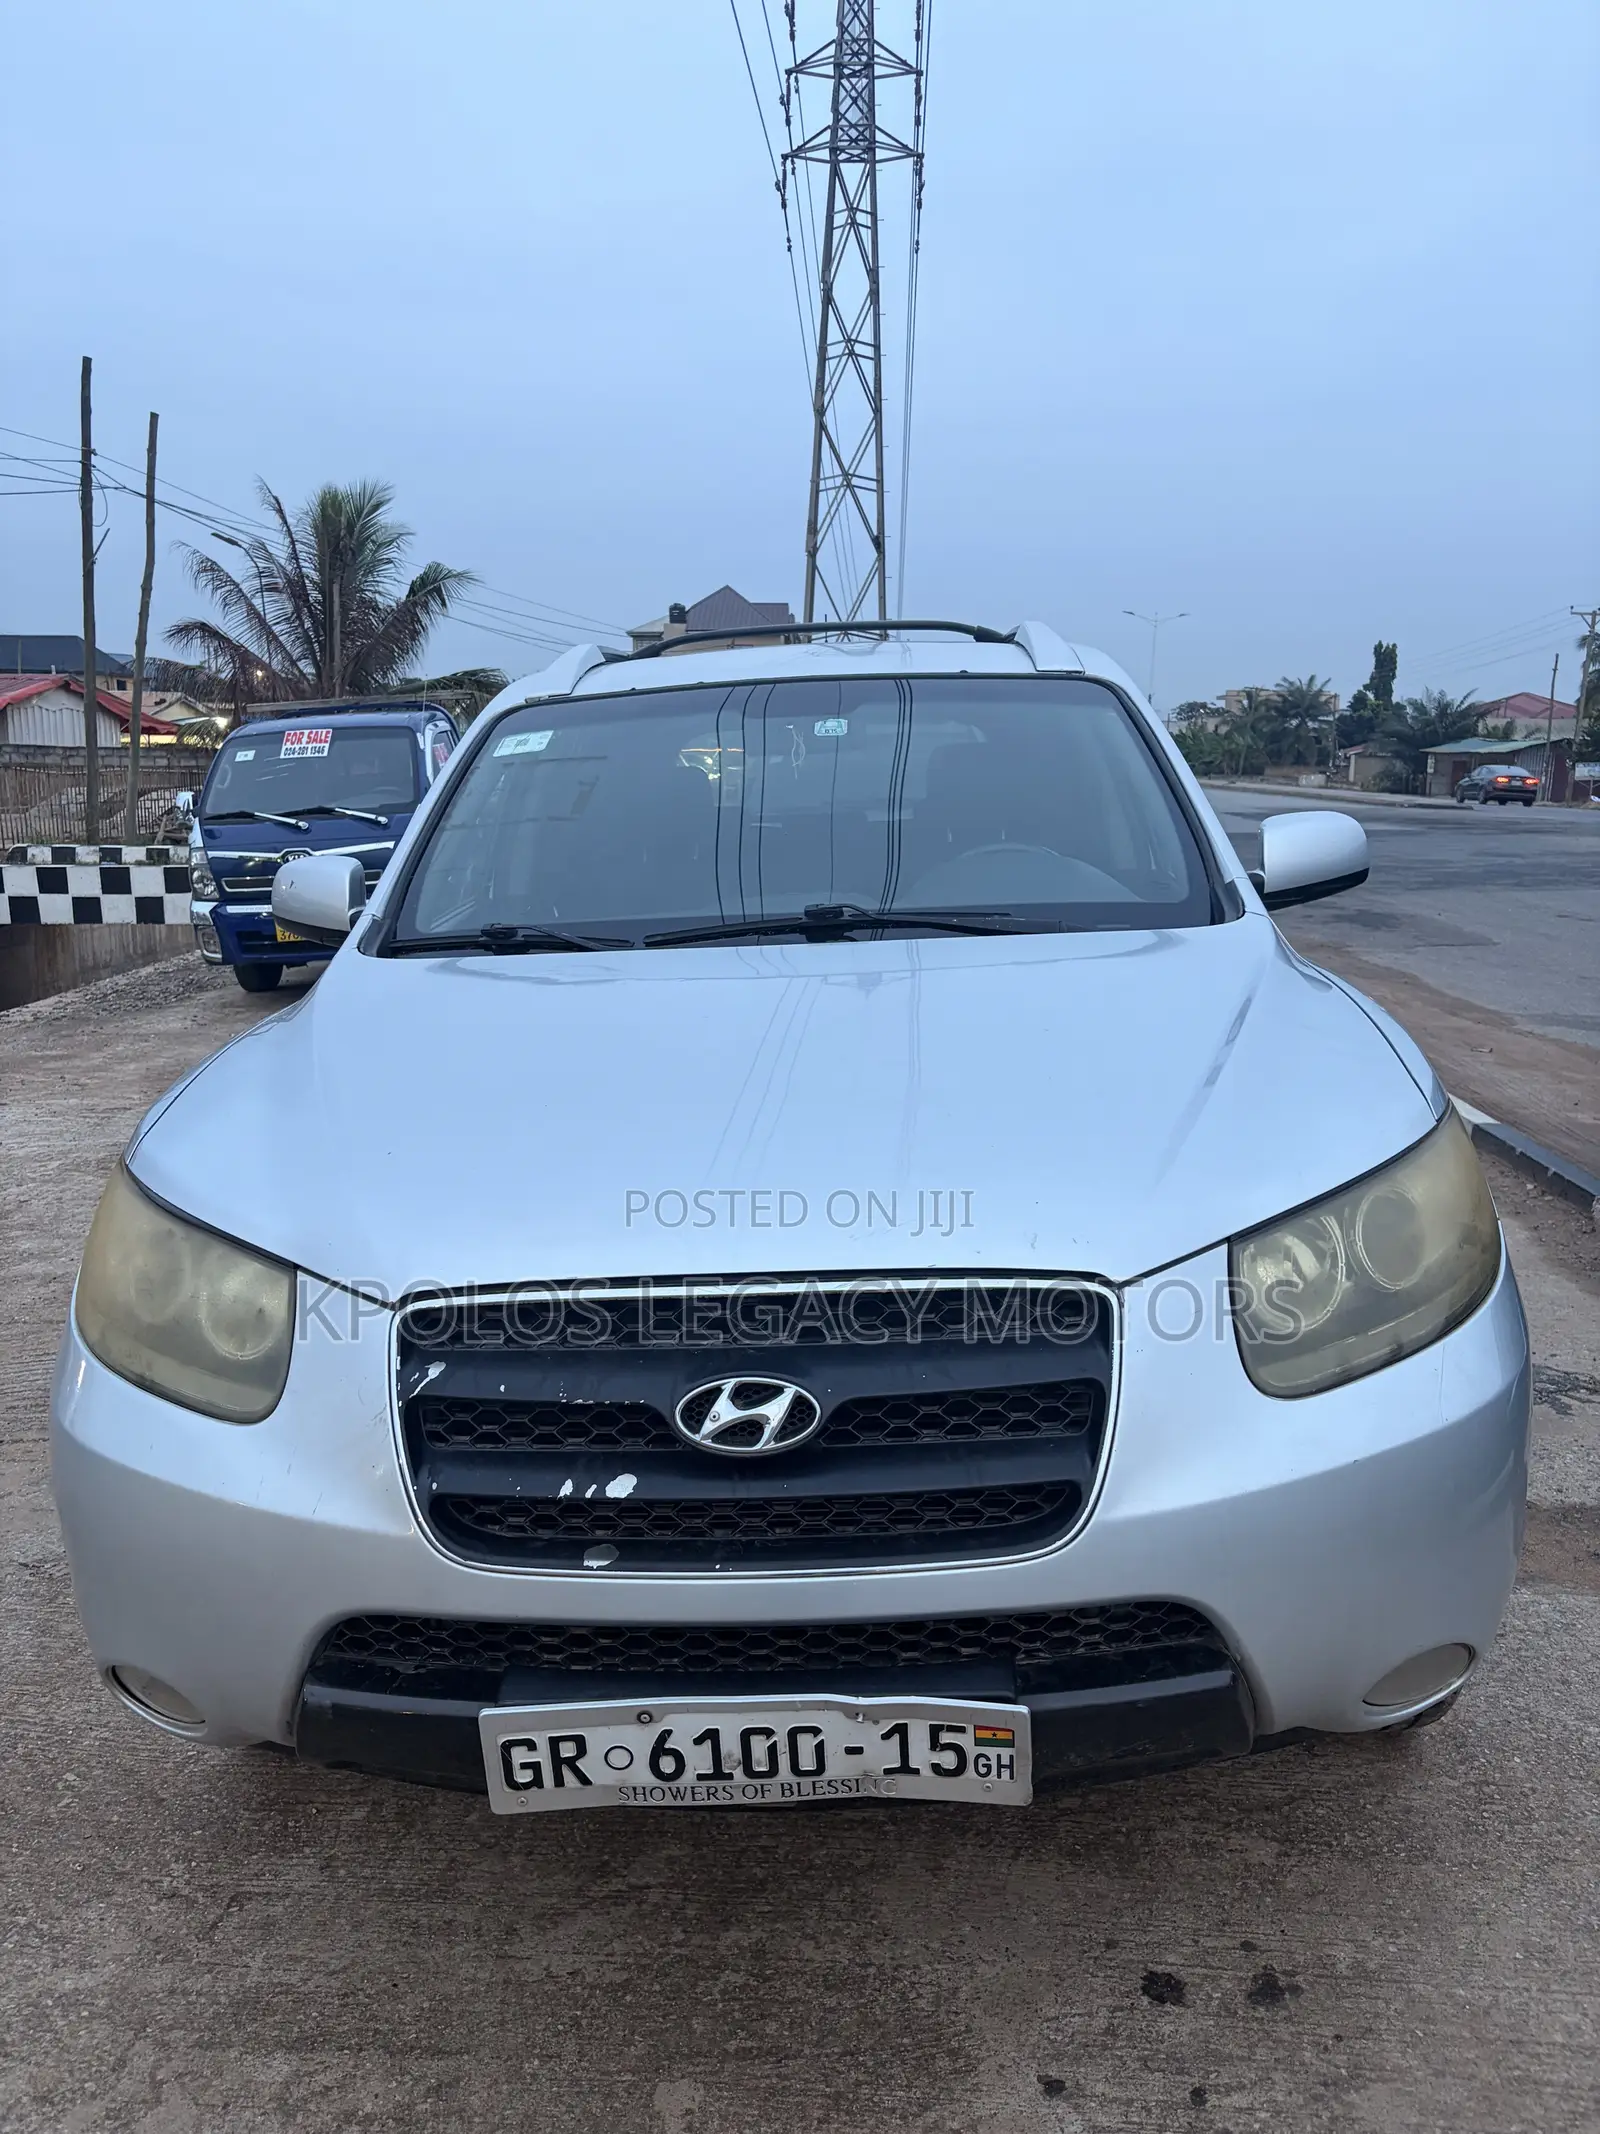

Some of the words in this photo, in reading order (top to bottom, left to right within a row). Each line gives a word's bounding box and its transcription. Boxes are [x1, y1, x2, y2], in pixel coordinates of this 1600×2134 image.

[284, 731, 305, 746] FOR
[306, 730, 331, 745] SALE
[500, 1737, 594, 1791] GR
[973, 1752, 1015, 1781] GH
[618, 1785, 734, 1803] SHOWERS
[741, 1783, 774, 1801] OF
